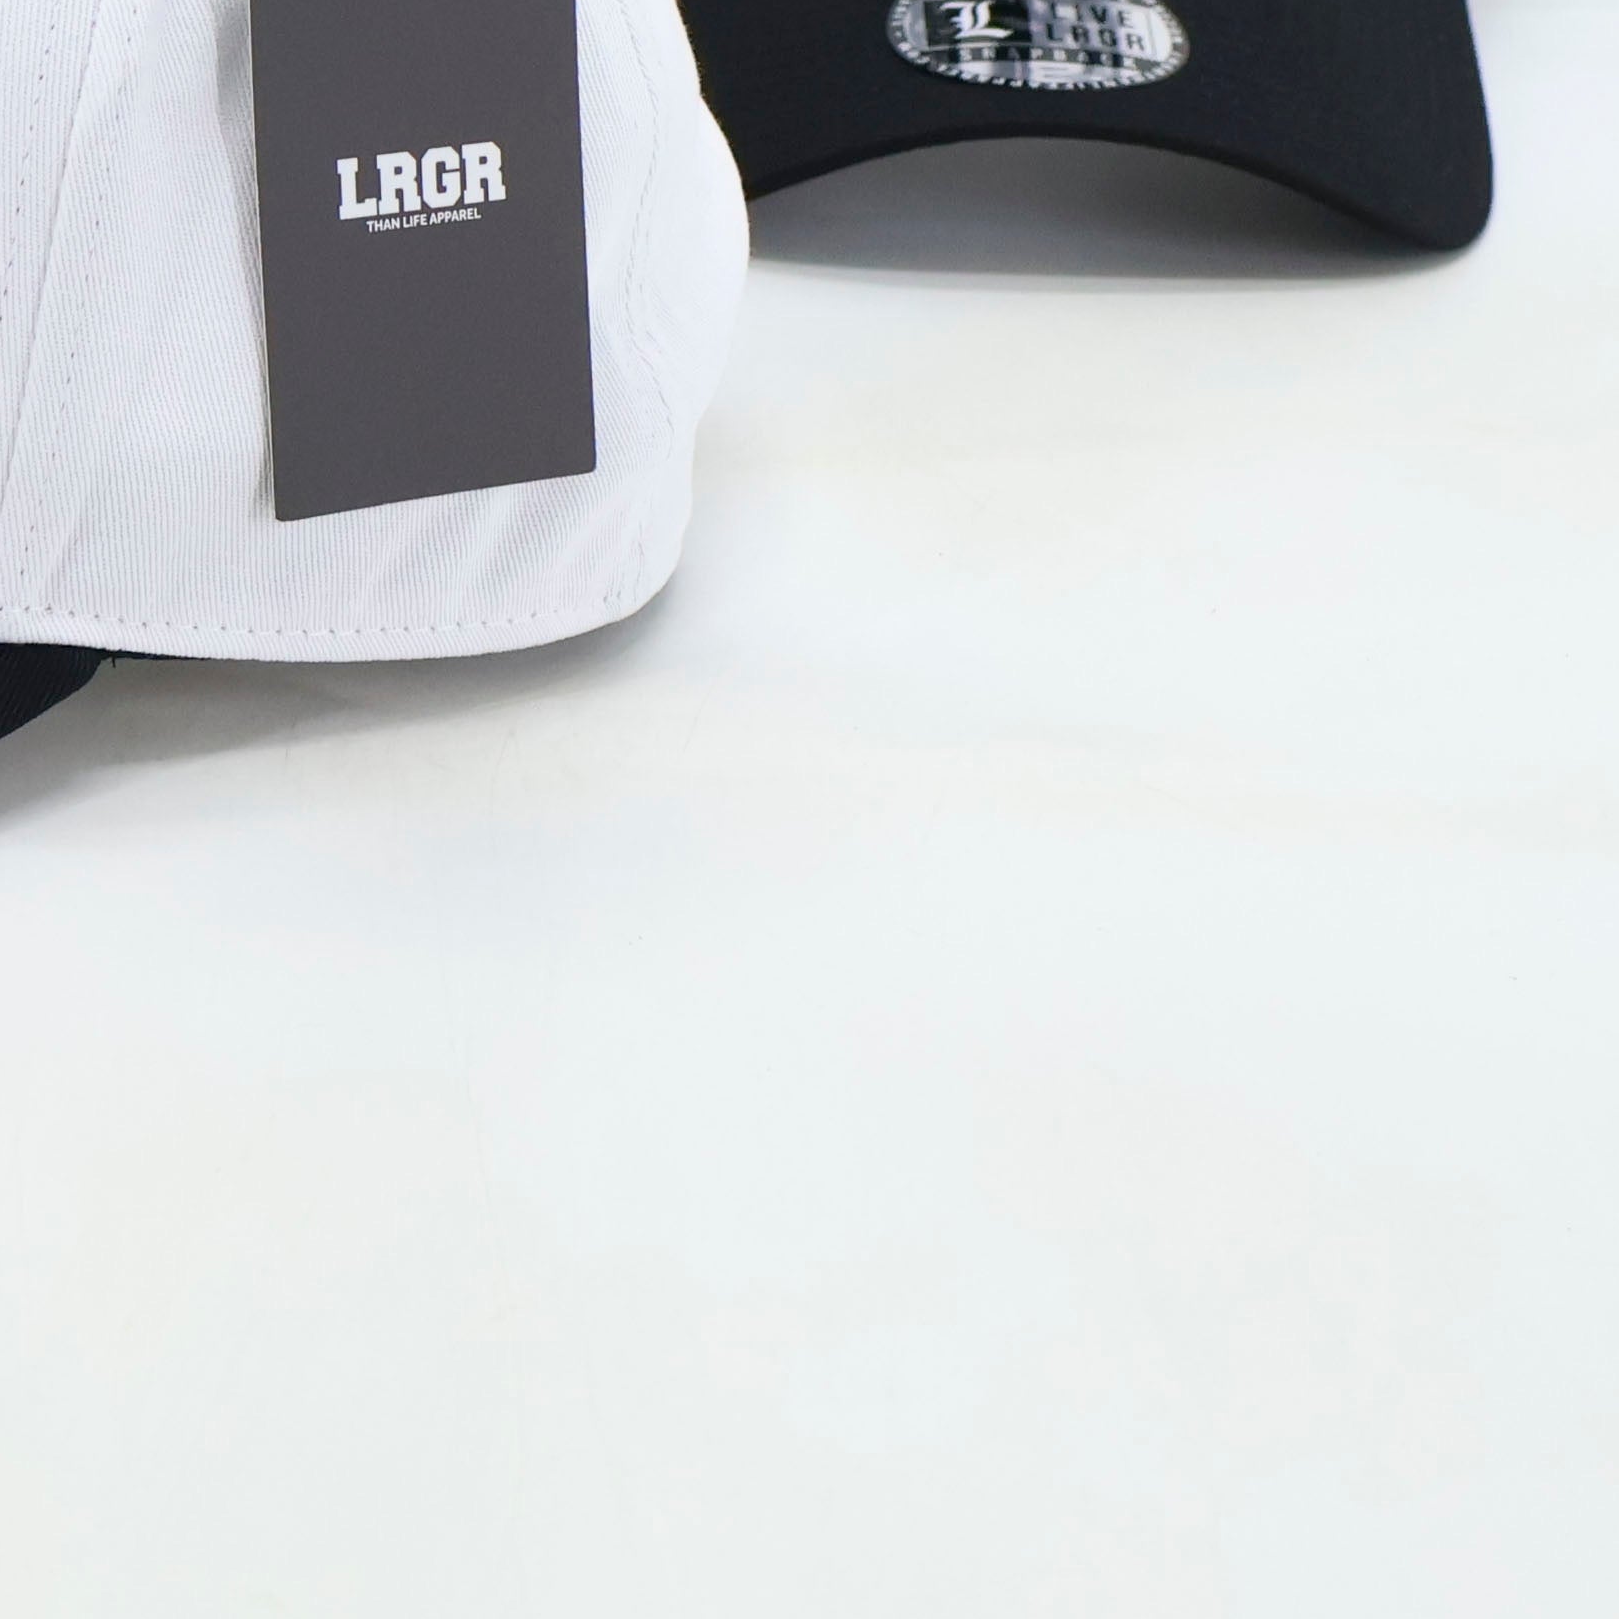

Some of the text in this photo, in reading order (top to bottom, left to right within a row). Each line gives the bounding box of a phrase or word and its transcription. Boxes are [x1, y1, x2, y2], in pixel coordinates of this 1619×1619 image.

[1051, 3, 1136, 28] LIVE
[336, 141, 507, 220] LRGR
[366, 207, 482, 233] THAN LIFE APPAREL
